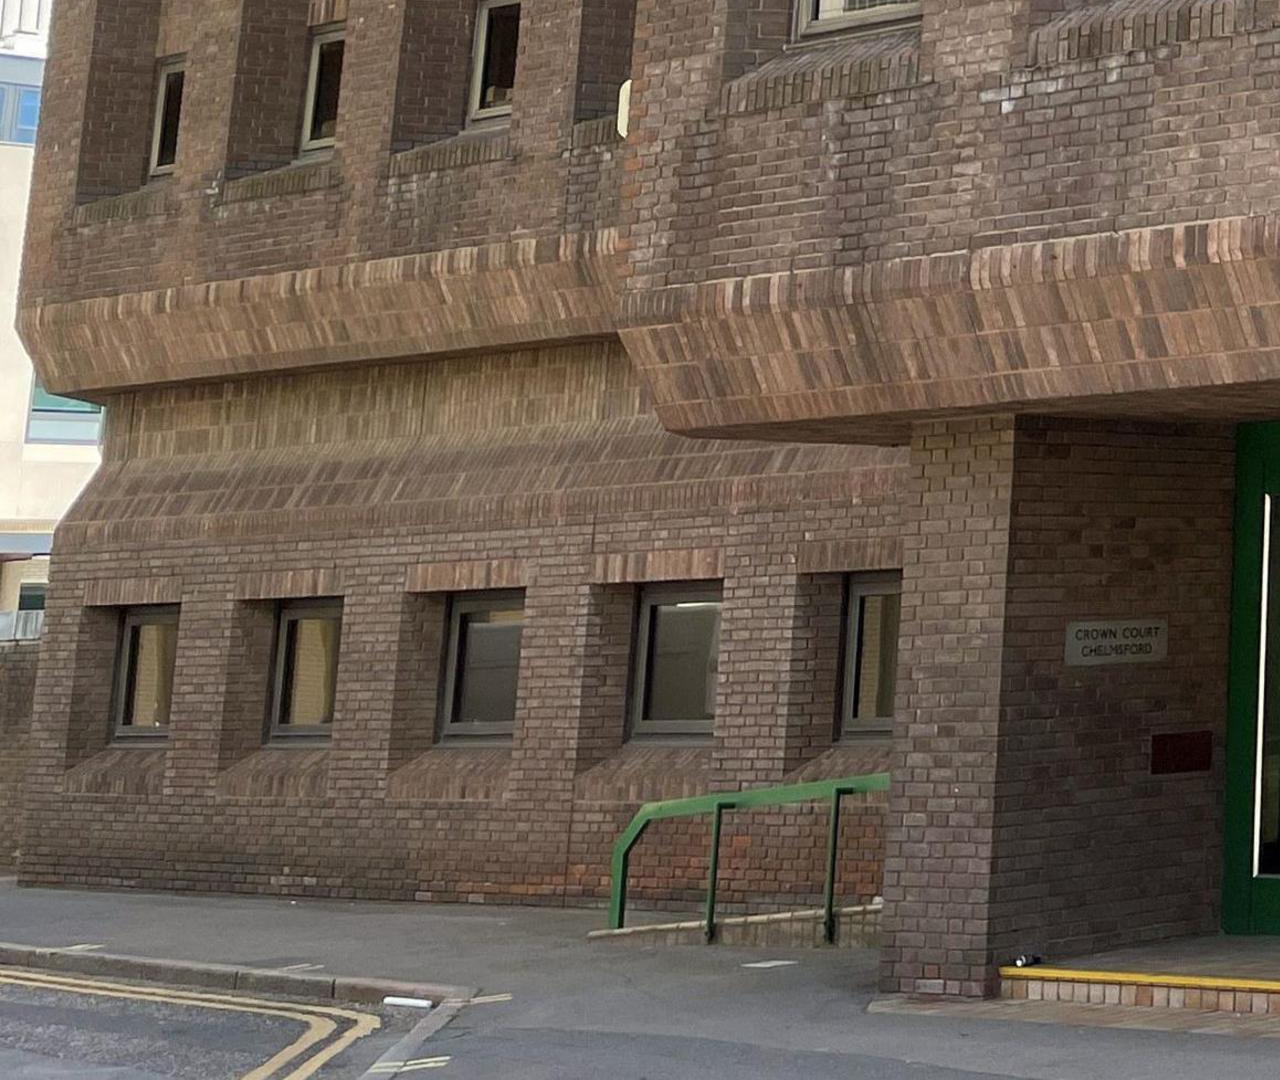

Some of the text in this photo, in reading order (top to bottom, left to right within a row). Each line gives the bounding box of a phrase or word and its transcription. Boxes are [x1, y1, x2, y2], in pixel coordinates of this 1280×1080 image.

[1075, 626, 1160, 641] CROWN COURT
[1081, 643, 1153, 657] CHELMSFORD
